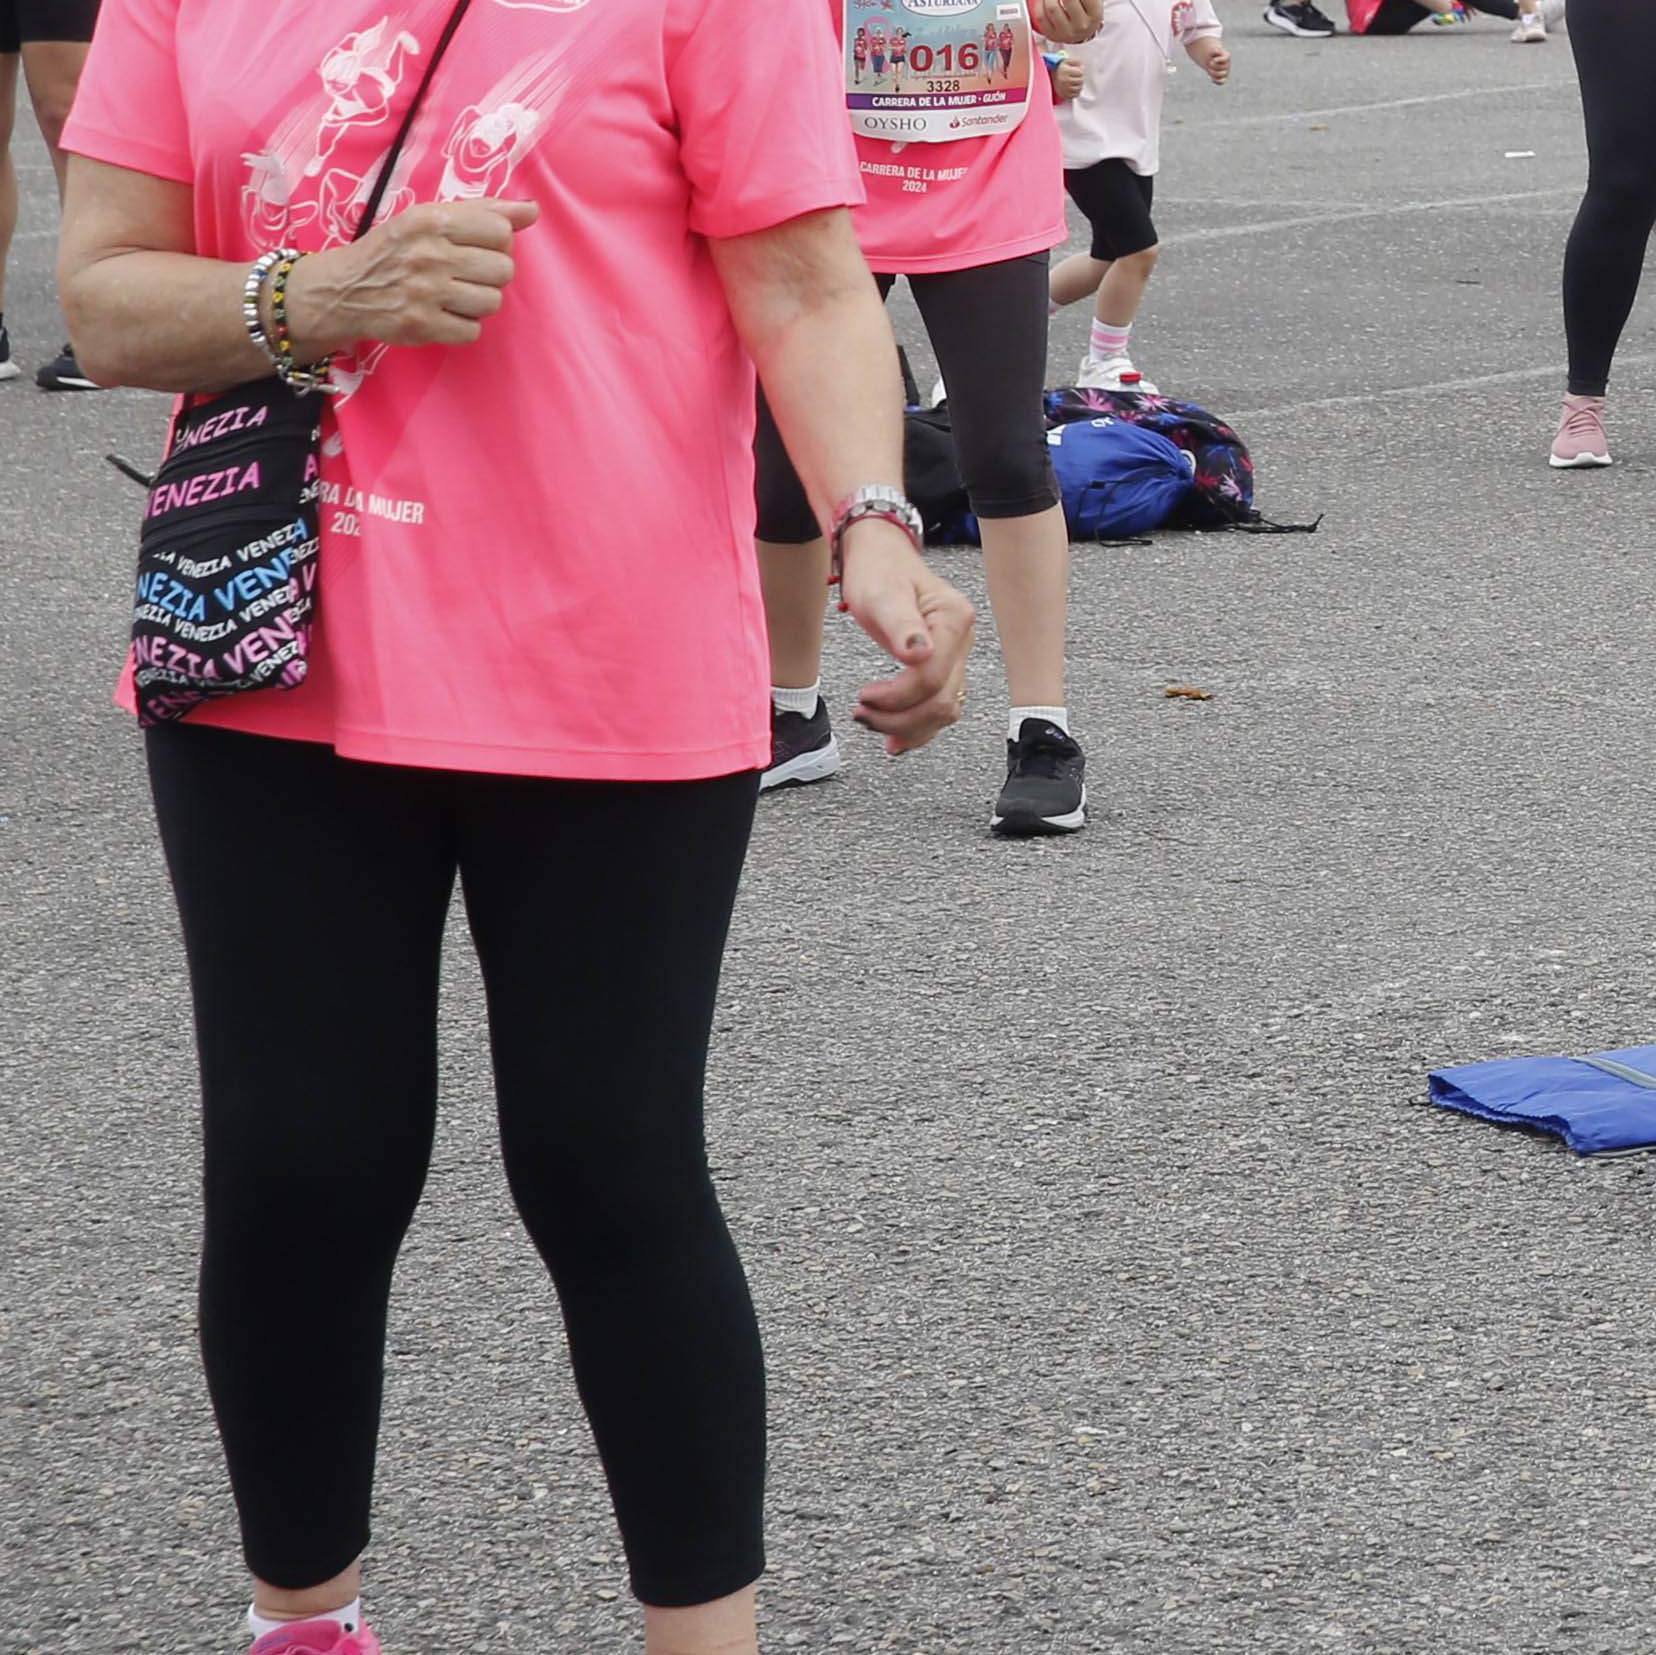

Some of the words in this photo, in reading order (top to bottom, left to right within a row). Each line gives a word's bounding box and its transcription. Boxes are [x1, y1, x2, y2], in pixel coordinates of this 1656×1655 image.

[910, 42, 980, 73] 016
[926, 79, 961, 93] 3328
[871, 96, 916, 108] CARRERA
[918, 95, 931, 107] DE
[932, 94, 946, 107] LA
[947, 93, 978, 106] MUJER
[864, 116, 928, 132] OYSHO
[961, 114, 1008, 129] Santander
[860, 161, 905, 178] CARRERA
[907, 168, 921, 180] DE
[923, 168, 936, 181] LA
[902, 179, 928, 194] 2024
[368, 493, 426, 525] MUJER
[177, 555, 232, 578] VENEZIA
[174, 619, 238, 642] VENEZIA
